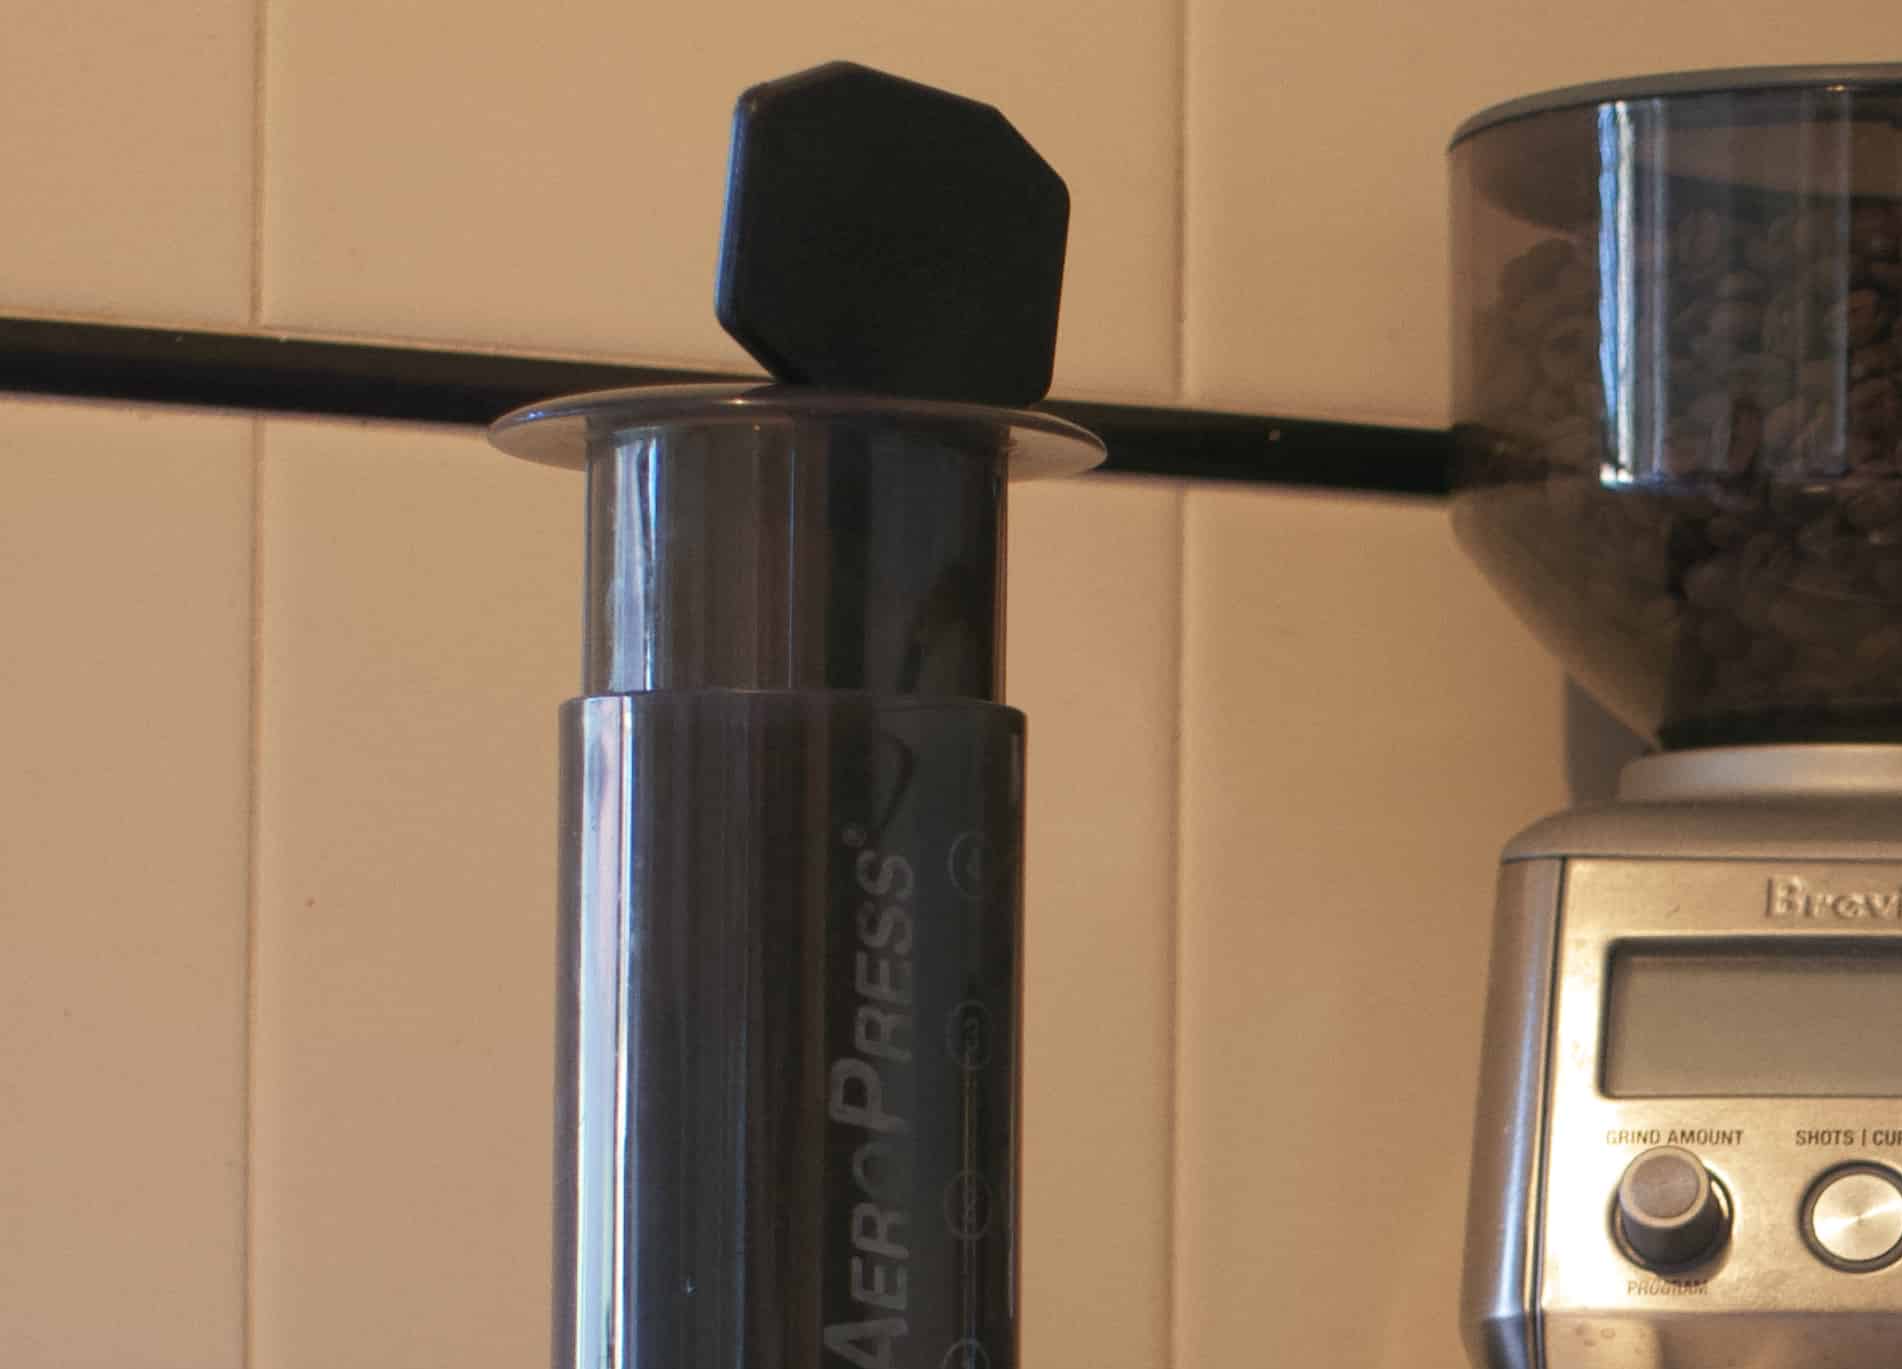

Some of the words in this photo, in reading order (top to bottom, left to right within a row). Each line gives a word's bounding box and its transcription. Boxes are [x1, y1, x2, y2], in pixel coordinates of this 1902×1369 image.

[1606, 1129, 1661, 1146] GRIND
[1666, 1128, 1745, 1146] AMOUNT
[1795, 1128, 1854, 1146] SHOTS
